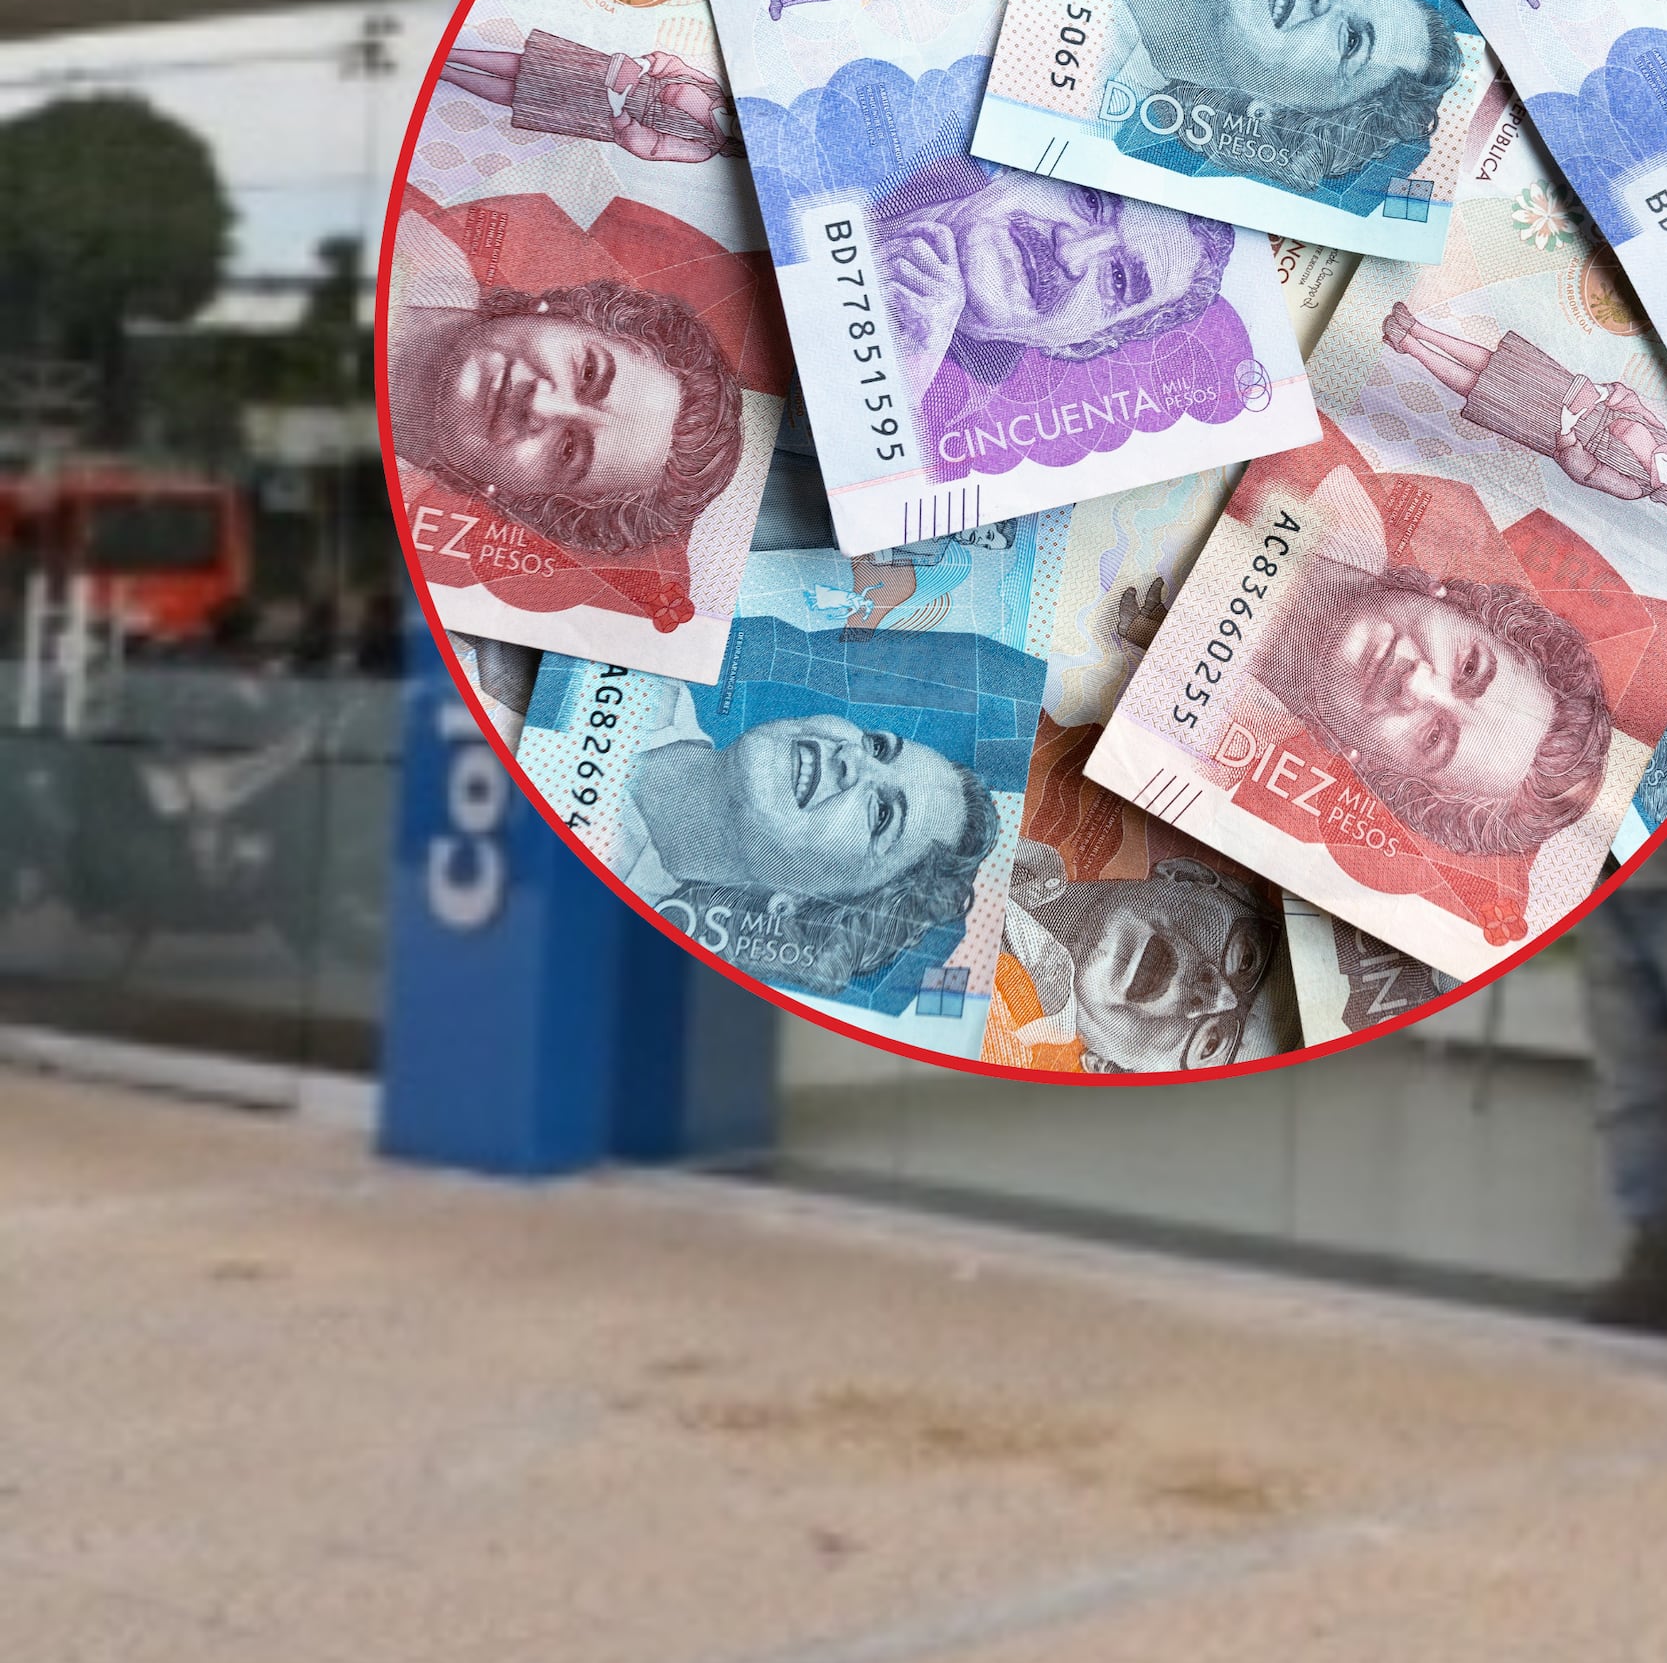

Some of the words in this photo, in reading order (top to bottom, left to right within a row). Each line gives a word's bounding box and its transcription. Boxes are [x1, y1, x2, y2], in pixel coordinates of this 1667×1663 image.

[1099, 79, 1217, 146] DOS
[1222, 113, 1262, 138] MIL
[1218, 133, 1291, 167] PESOS
[1567, 256, 1579, 281] RANA
[825, 220, 905, 461] BD77851595
[938, 387, 1161, 463] CINCUENTA
[1162, 378, 1194, 395] MIL
[1165, 386, 1217, 410] PESOS
[404, 502, 480, 560] EZ
[484, 522, 527, 547] MIL
[479, 544, 555, 577] PESOS
[1173, 510, 1300, 729] AC83660255
[565, 664, 628, 828] AG82694
[1215, 722, 1337, 817] DIEZ
[1337, 786, 1377, 820] MIL
[1327, 806, 1399, 857] PESOS
[735, 936, 814, 966] PESOS
[740, 912, 783, 936] MIL
